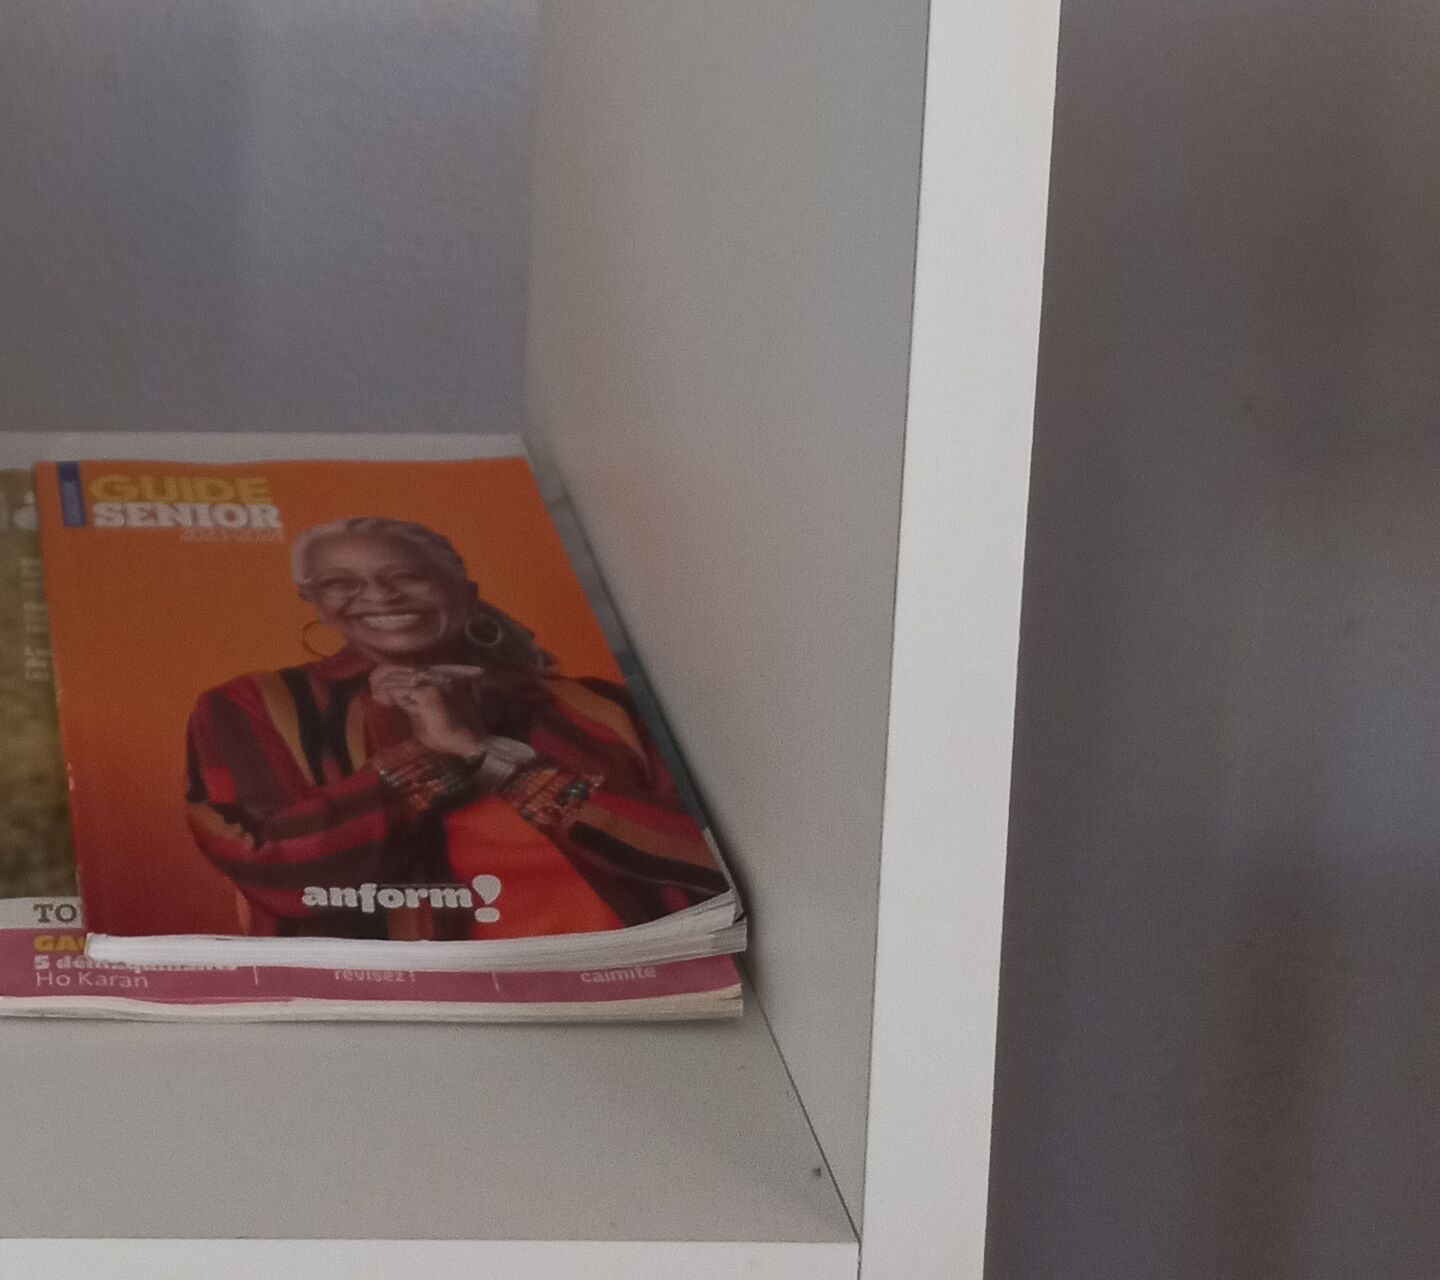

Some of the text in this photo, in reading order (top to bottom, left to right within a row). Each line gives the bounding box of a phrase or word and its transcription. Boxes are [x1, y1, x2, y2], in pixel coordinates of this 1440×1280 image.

[90, 475, 273, 504] GUIDE
[94, 502, 282, 528] SENIOR
[302, 874, 502, 923] anform!
[36, 972, 150, 989] Ho Karan
